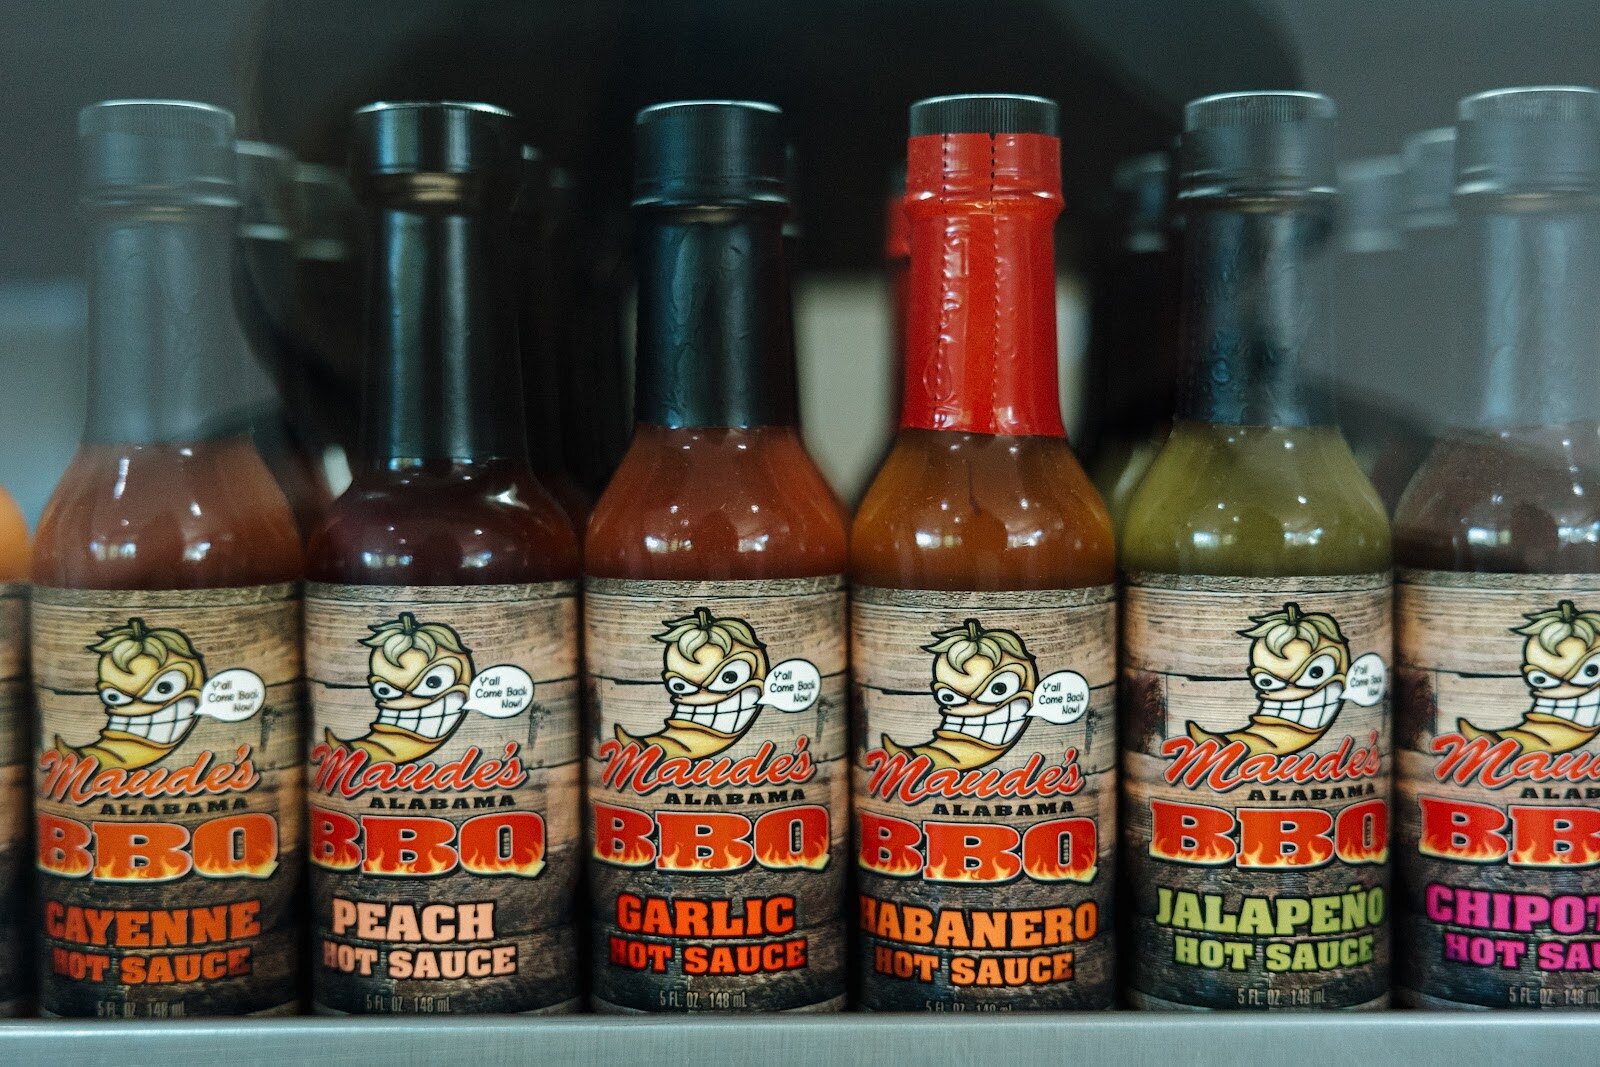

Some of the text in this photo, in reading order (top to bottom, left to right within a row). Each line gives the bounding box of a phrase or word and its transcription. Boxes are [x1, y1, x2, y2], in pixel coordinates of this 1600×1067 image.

[475, 686, 527, 698] Come Back
[480, 676, 500, 686] Y'all
[770, 681, 815, 693] Come Back
[774, 670, 792, 681] Y'all
[1043, 682, 1061, 692] Y'all
[1039, 692, 1084, 705] Come Back
[1062, 704, 1080, 714] Now!
[39, 743, 260, 806] Maude's
[310, 741, 527, 799] Maude's
[600, 735, 816, 795] Maude's
[864, 747, 1085, 804] Maude's
[1162, 729, 1381, 792] Maude's
[1430, 732, 1600, 789] Mau
[101, 798, 249, 815] ALABAMA
[369, 794, 516, 810] ALABAMA
[664, 789, 805, 805] ALABAMA
[932, 801, 1075, 816] ALABAMA
[1249, 783, 1375, 801] ALABAMA
[38, 812, 279, 882] BBQ
[310, 804, 546, 877] BBQ
[593, 803, 831, 872] BBQ
[859, 811, 1098, 884] BBQ
[1149, 798, 1389, 870] BBQ
[46, 900, 262, 947] CAYENNE
[333, 897, 495, 943] PEACH
[617, 893, 796, 937] GARLIC
[859, 895, 1099, 948] HABANERO
[1155, 884, 1386, 936] JALAPEÑO
[52, 947, 251, 984] HOT SAUCE
[323, 940, 517, 980] HOT SAUCE
[609, 937, 808, 975] HOT SAUCE
[875, 945, 1075, 985] HOT SAUCE
[1175, 934, 1375, 972] HOT SAUCE
[1444, 932, 1526, 968] HOT
[366, 994, 373, 1010] 5
[414, 996, 434, 1012] 148
[437, 996, 451, 1012] mL
[660, 991, 666, 1006] 5
[669, 991, 683, 1007] FL.
[709, 992, 730, 1008] 148
[733, 991, 747, 1008] mL
[1237, 988, 1244, 1004] 5
[1248, 988, 1263, 1005] FL.
[1291, 988, 1310, 1005] 148
[1313, 988, 1327, 1003] mL
[1509, 986, 1516, 1002] 5
[1521, 987, 1535, 1004] FL.
[1564, 988, 1584, 1004] 148
